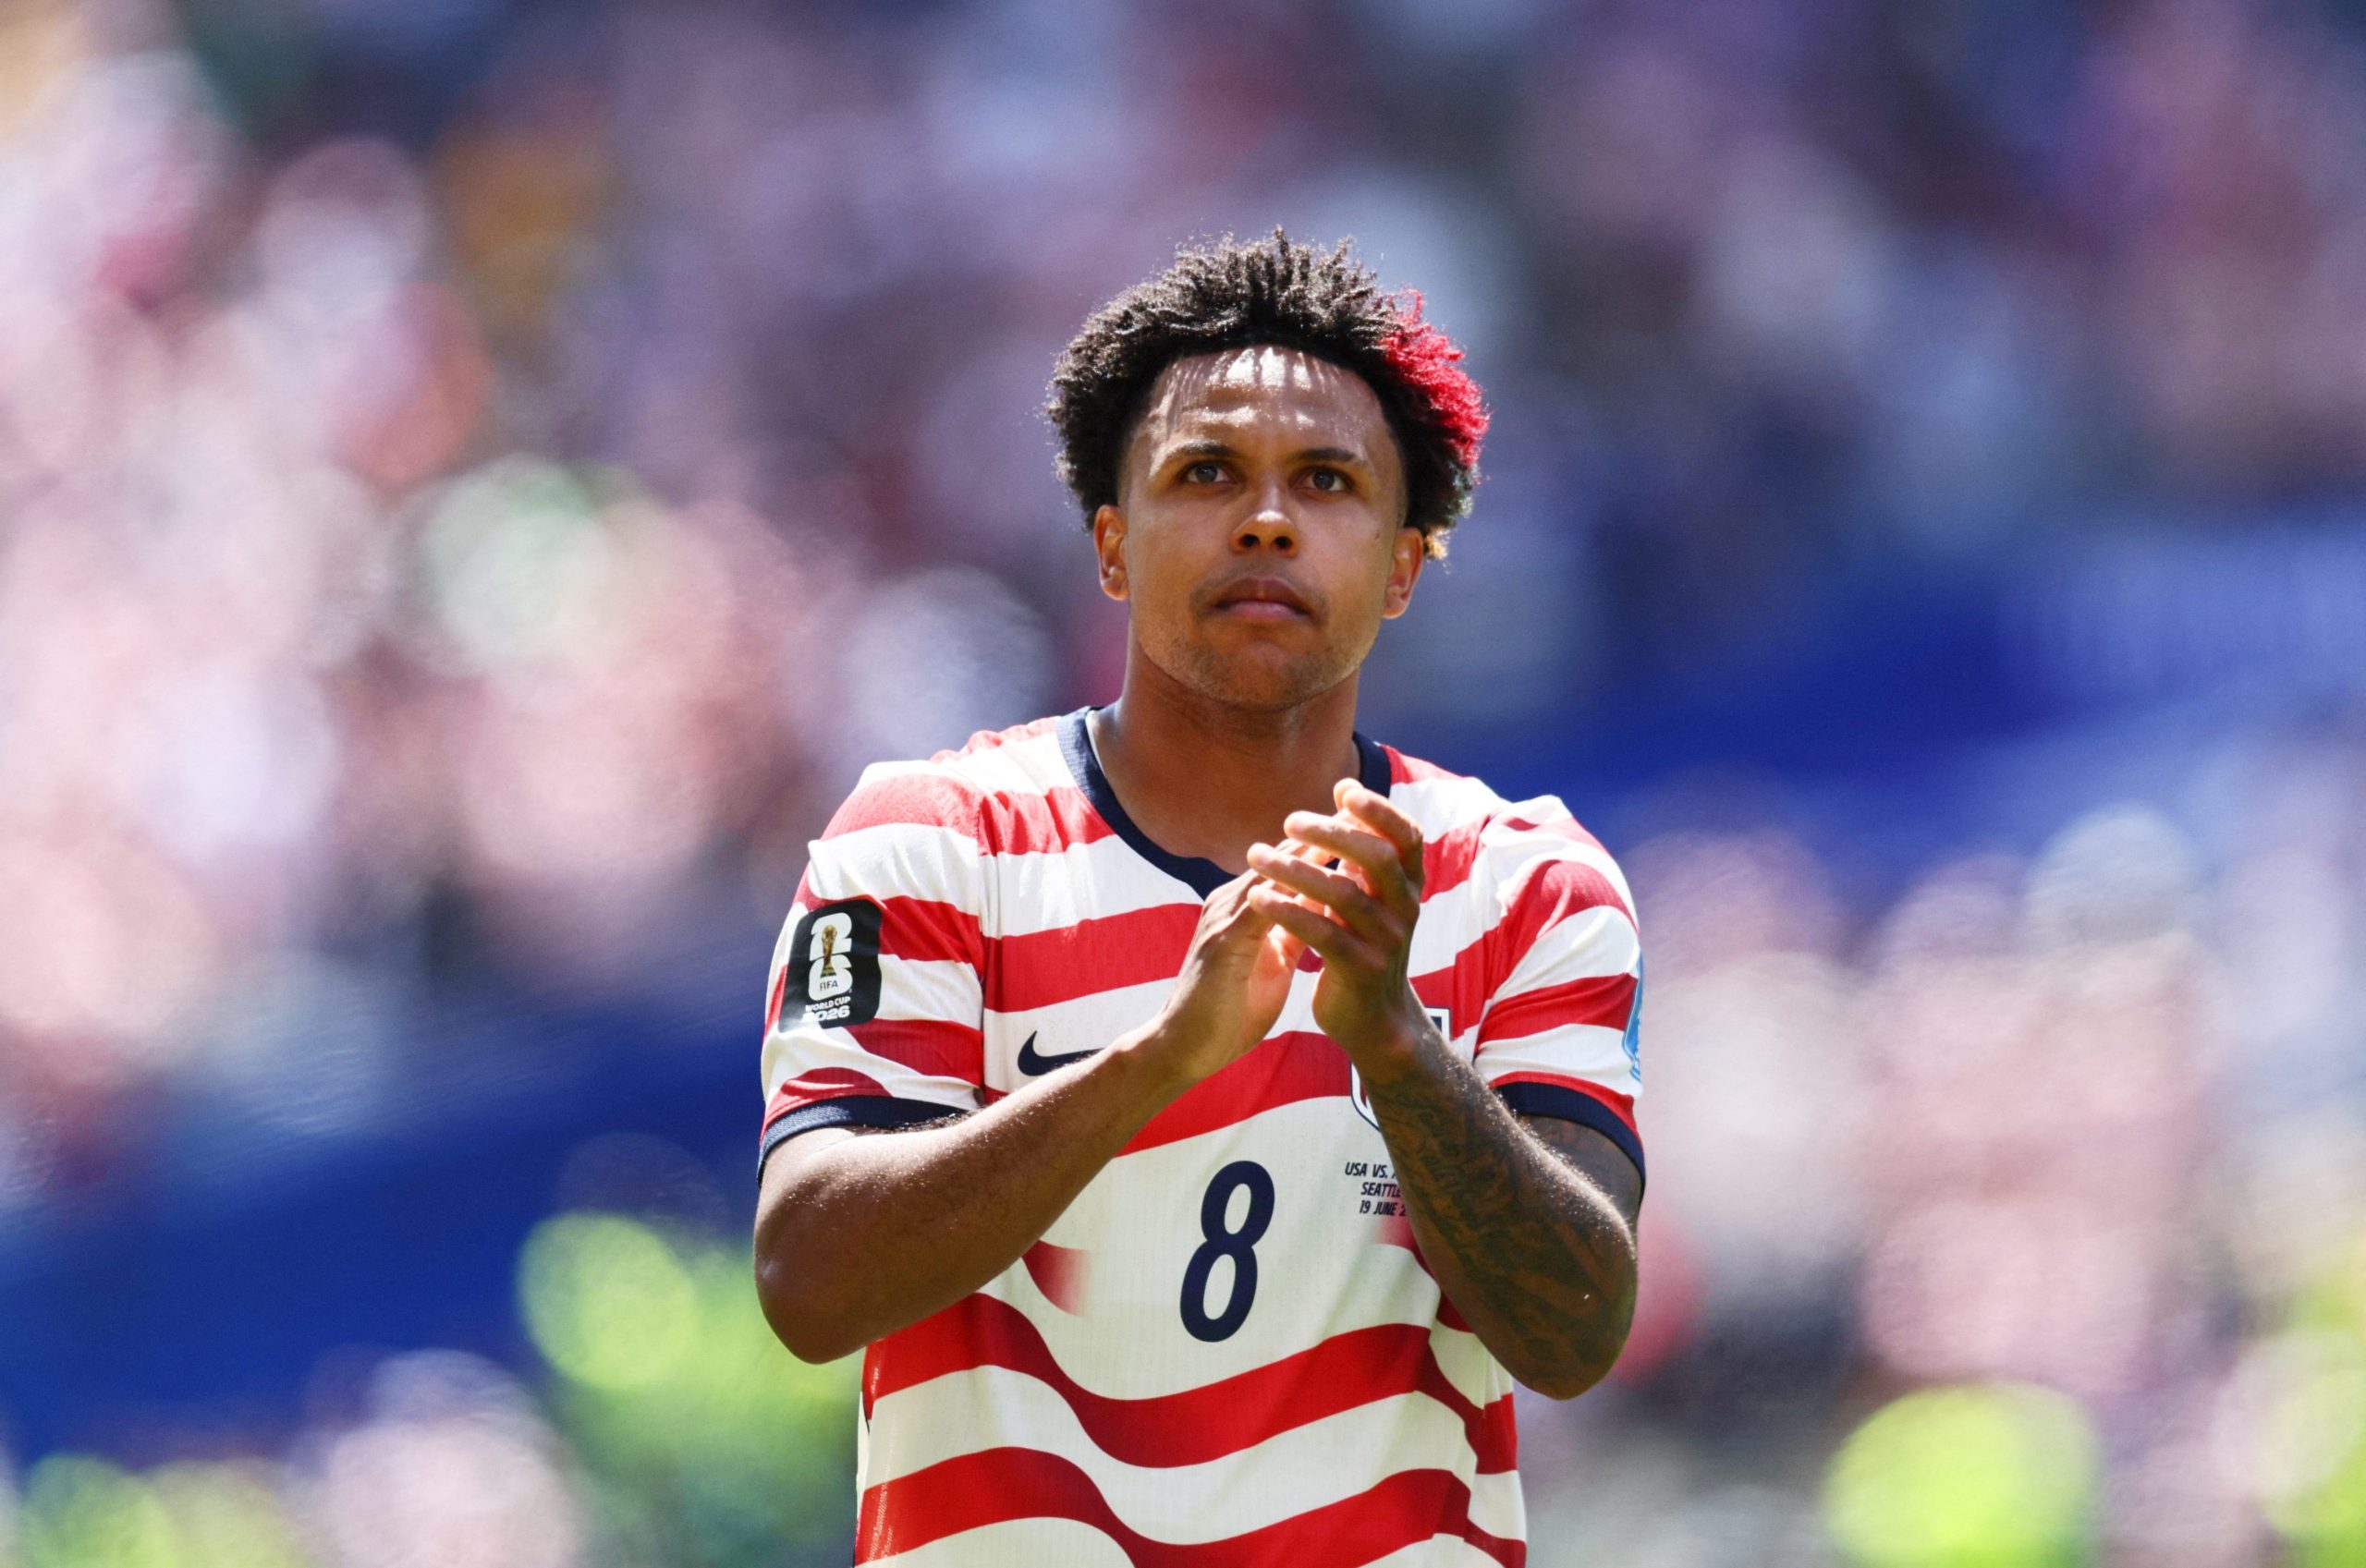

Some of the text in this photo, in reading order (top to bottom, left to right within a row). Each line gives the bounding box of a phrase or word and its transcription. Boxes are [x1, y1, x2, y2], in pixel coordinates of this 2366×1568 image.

[820, 979, 838, 991] FIFA
[805, 996, 851, 1012] WORLD CUP
[800, 1004, 850, 1023] 2026
[1345, 1161, 1368, 1177] USA
[1372, 1164, 1388, 1178] VS.
[1359, 1200, 1372, 1214] 19
[1373, 1201, 1397, 1217] JUNE
[1180, 1161, 1274, 1343] 8
